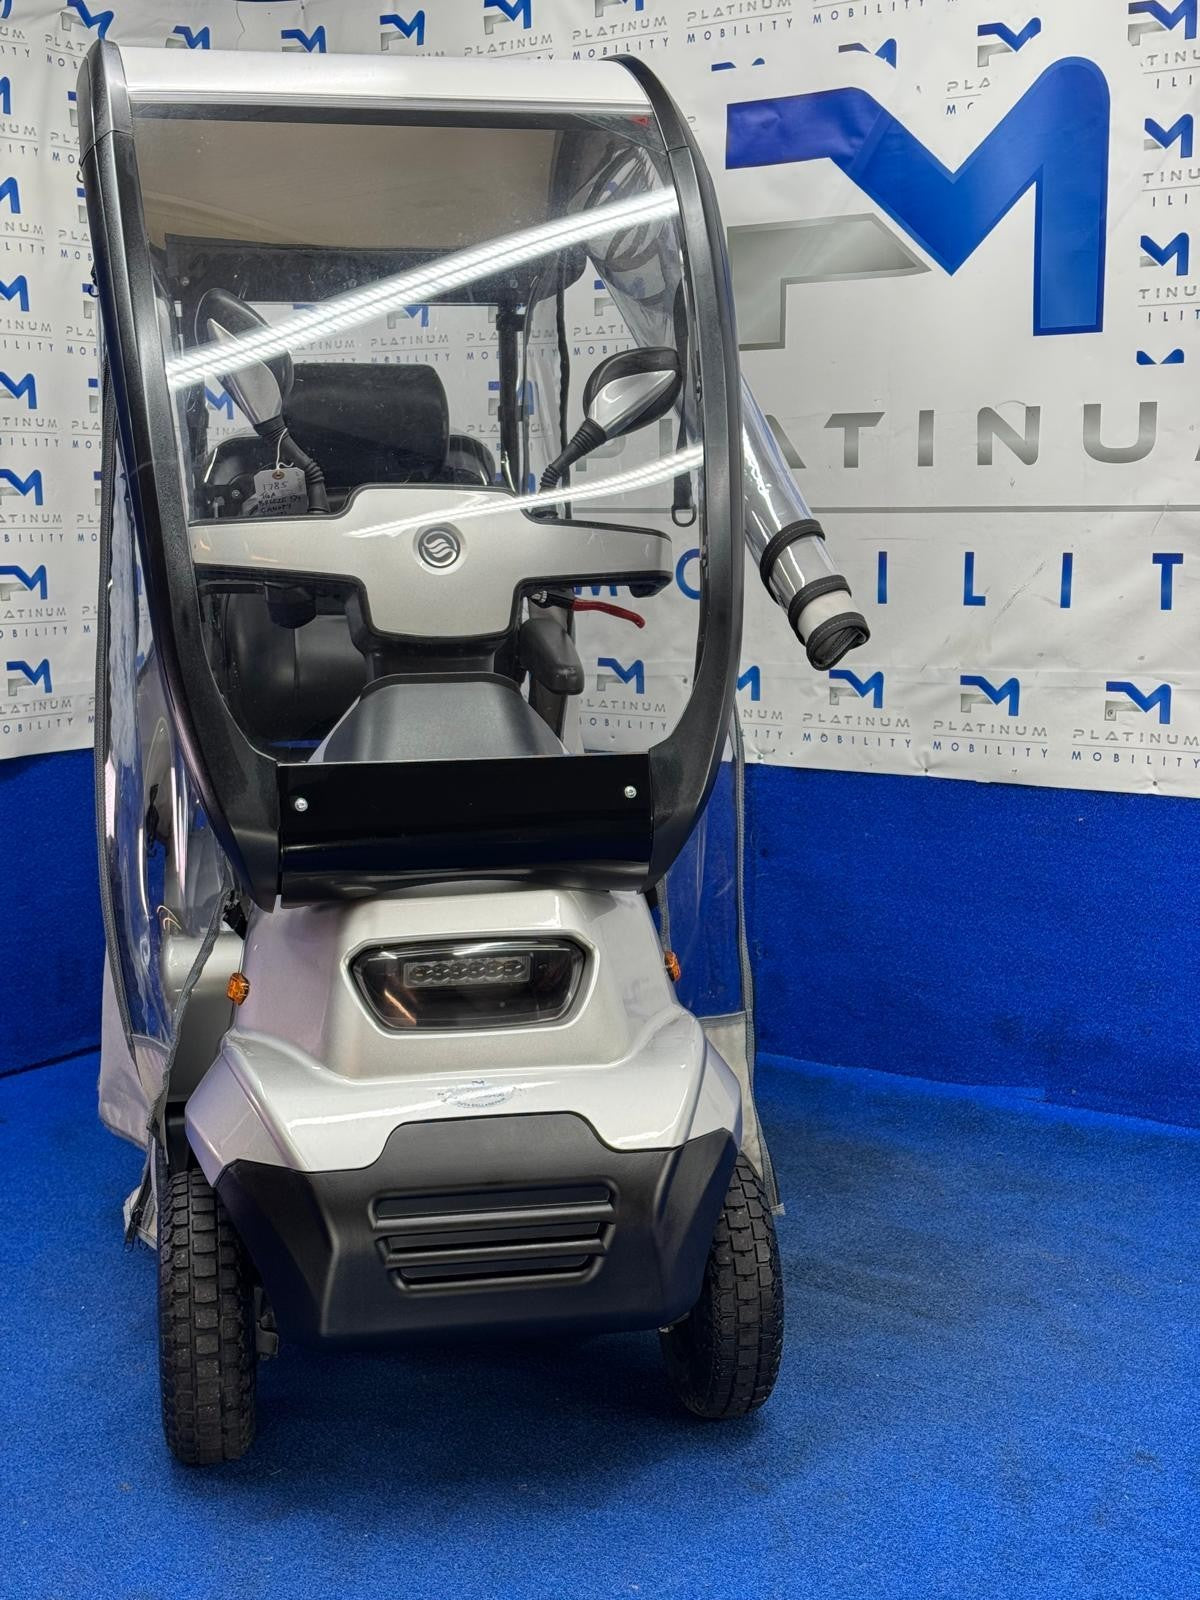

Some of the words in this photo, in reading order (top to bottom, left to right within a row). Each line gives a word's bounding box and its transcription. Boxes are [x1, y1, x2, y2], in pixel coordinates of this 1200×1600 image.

[572, 16, 668, 41] PLATINUM
[687, 18, 792, 43] MOBILITY
[464, 33, 554, 57] PLATINUM
[573, 37, 670, 60] MOBILITY
[371, 334, 449, 347] PLATINUM
[4, 533, 64, 543] BILITY
[4, 607, 67, 619] ATINUM
[0, 699, 72, 715] LATINUM
[2, 717, 73, 734] OBILITY
[802, 712, 911, 728] PLATINUM
[933, 720, 1047, 738] PLATINUM
[803, 733, 912, 748] MOBILITY
[1073, 729, 1200, 747] PLATINUM
[933, 741, 1048, 759] MOBILITY
[1072, 752, 1200, 768] MOBILITY
